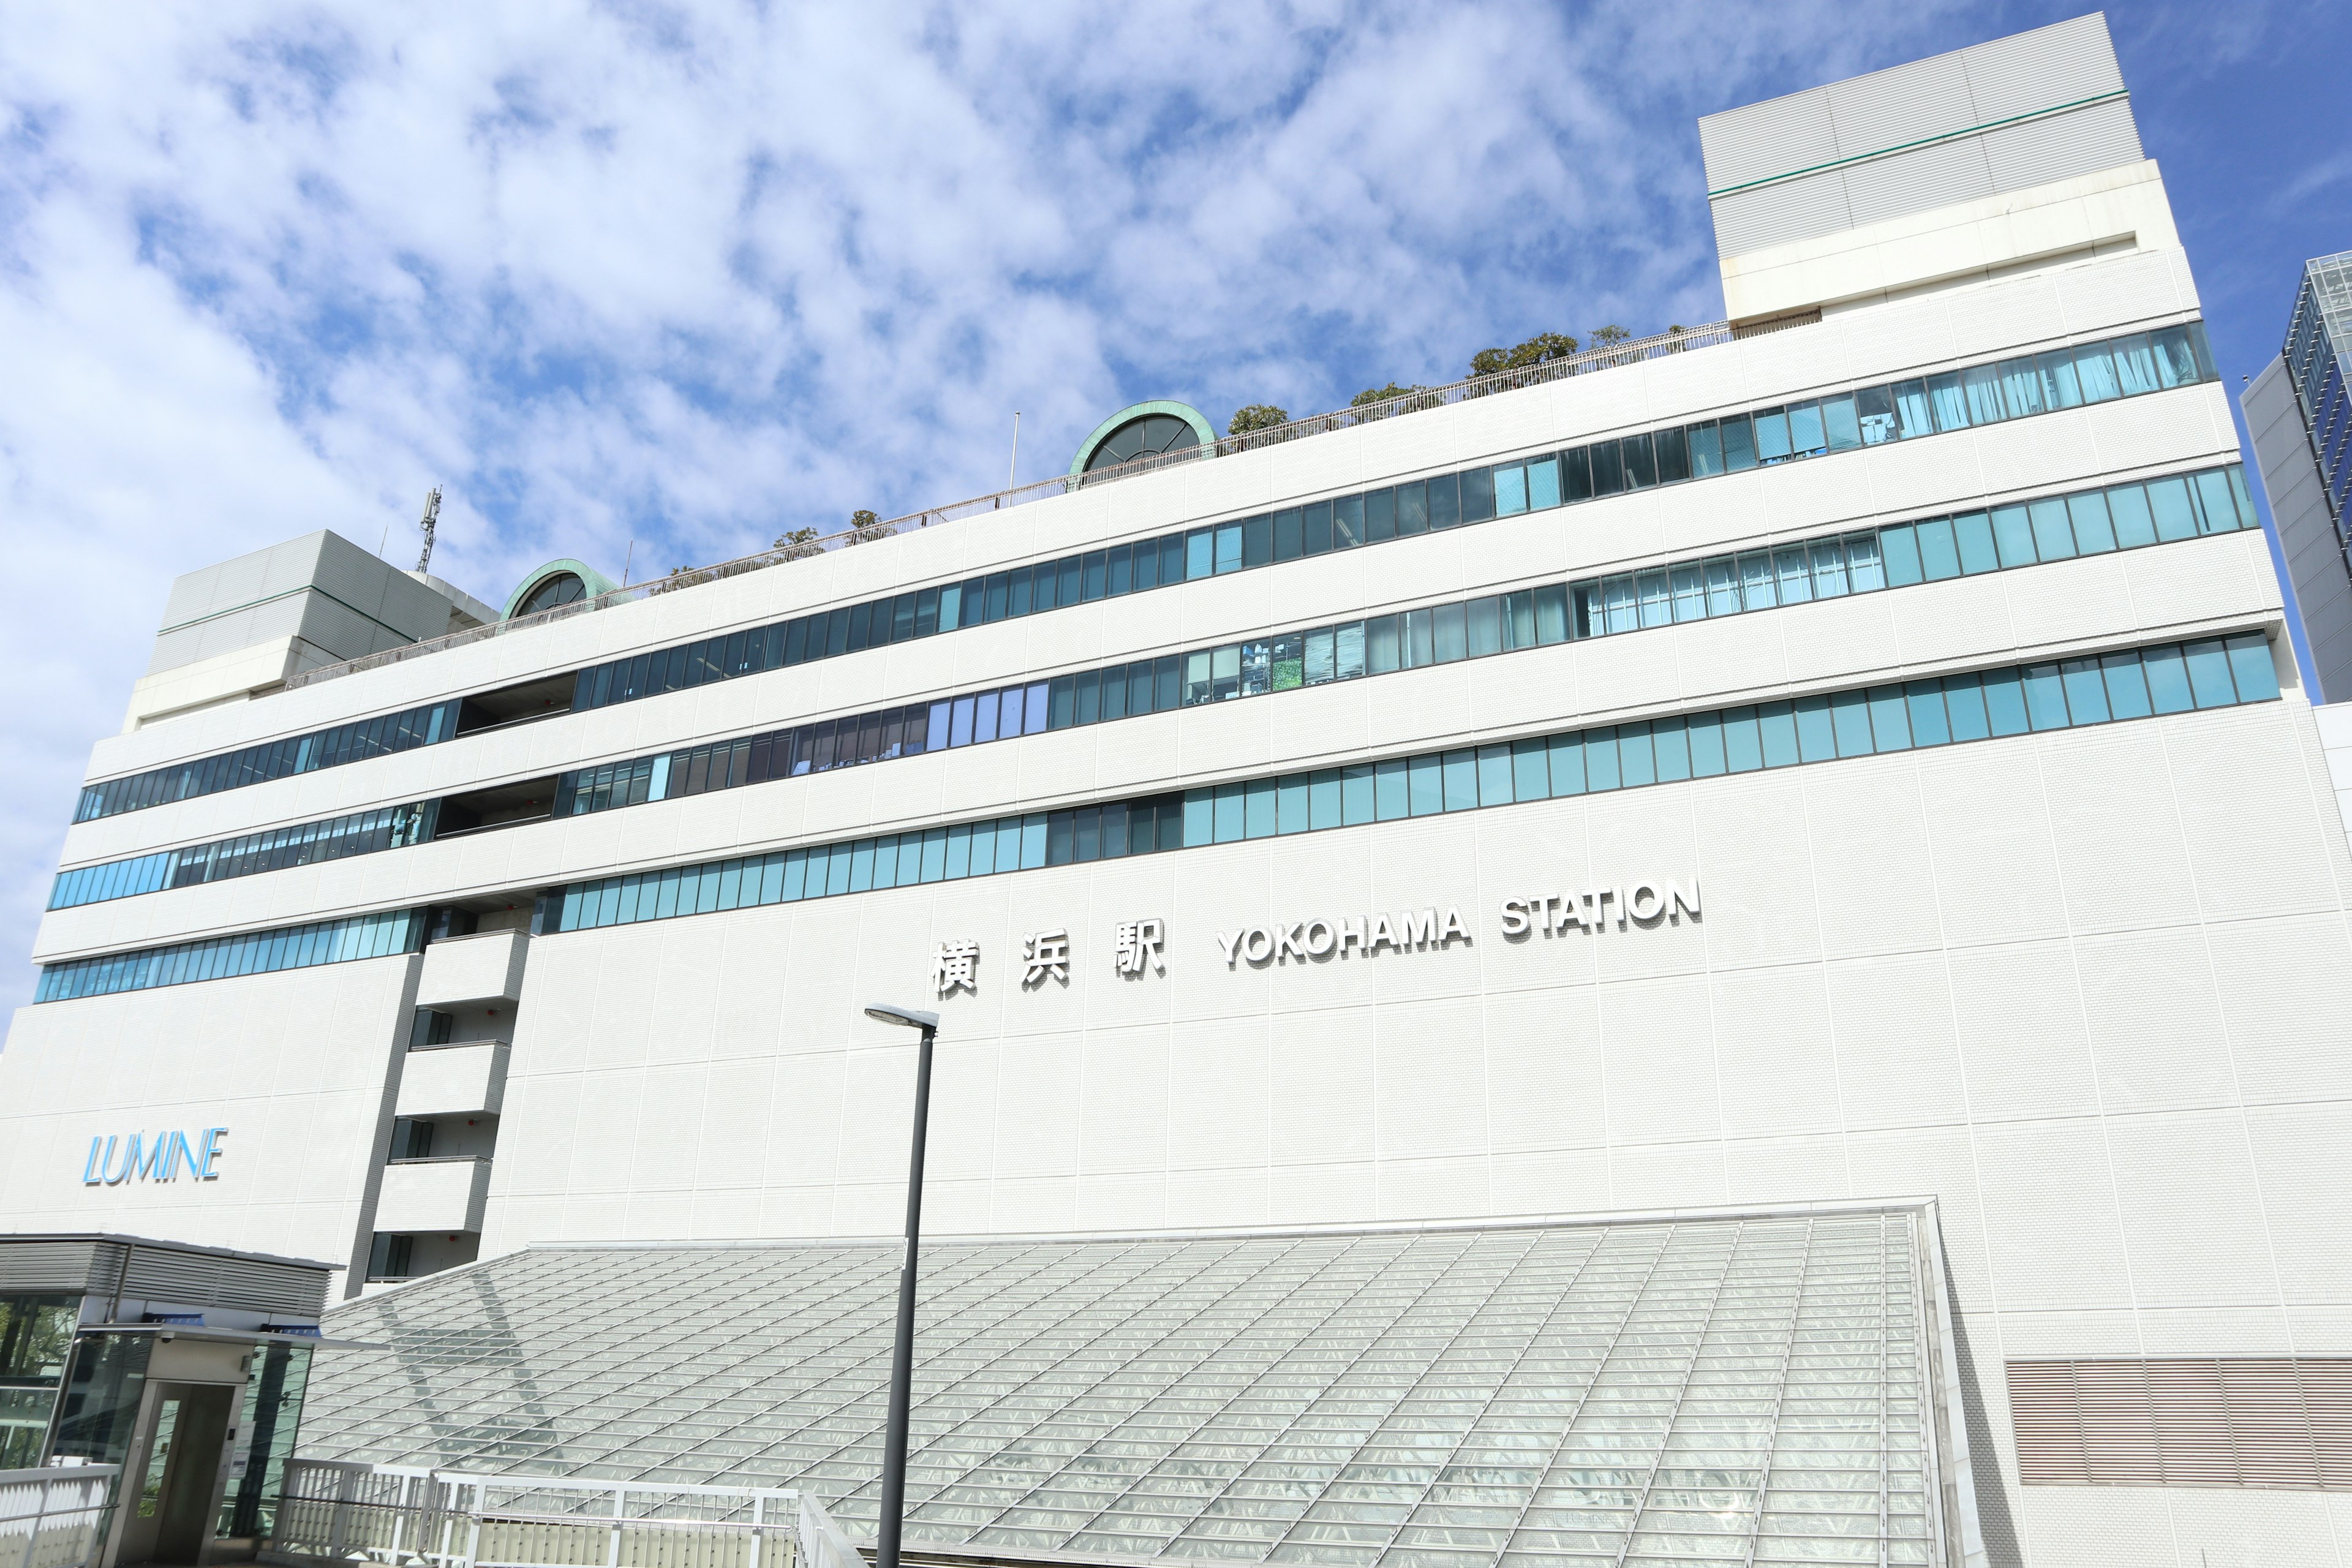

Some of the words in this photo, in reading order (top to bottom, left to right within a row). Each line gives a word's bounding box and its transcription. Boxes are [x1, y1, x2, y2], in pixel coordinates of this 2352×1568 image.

[930, 918, 1165, 992] 横浜駅
[1216, 903, 1471, 963] YOKOHAMA
[1500, 876, 1700, 935] STATION
[83, 1127, 228, 1185] LUMINE
